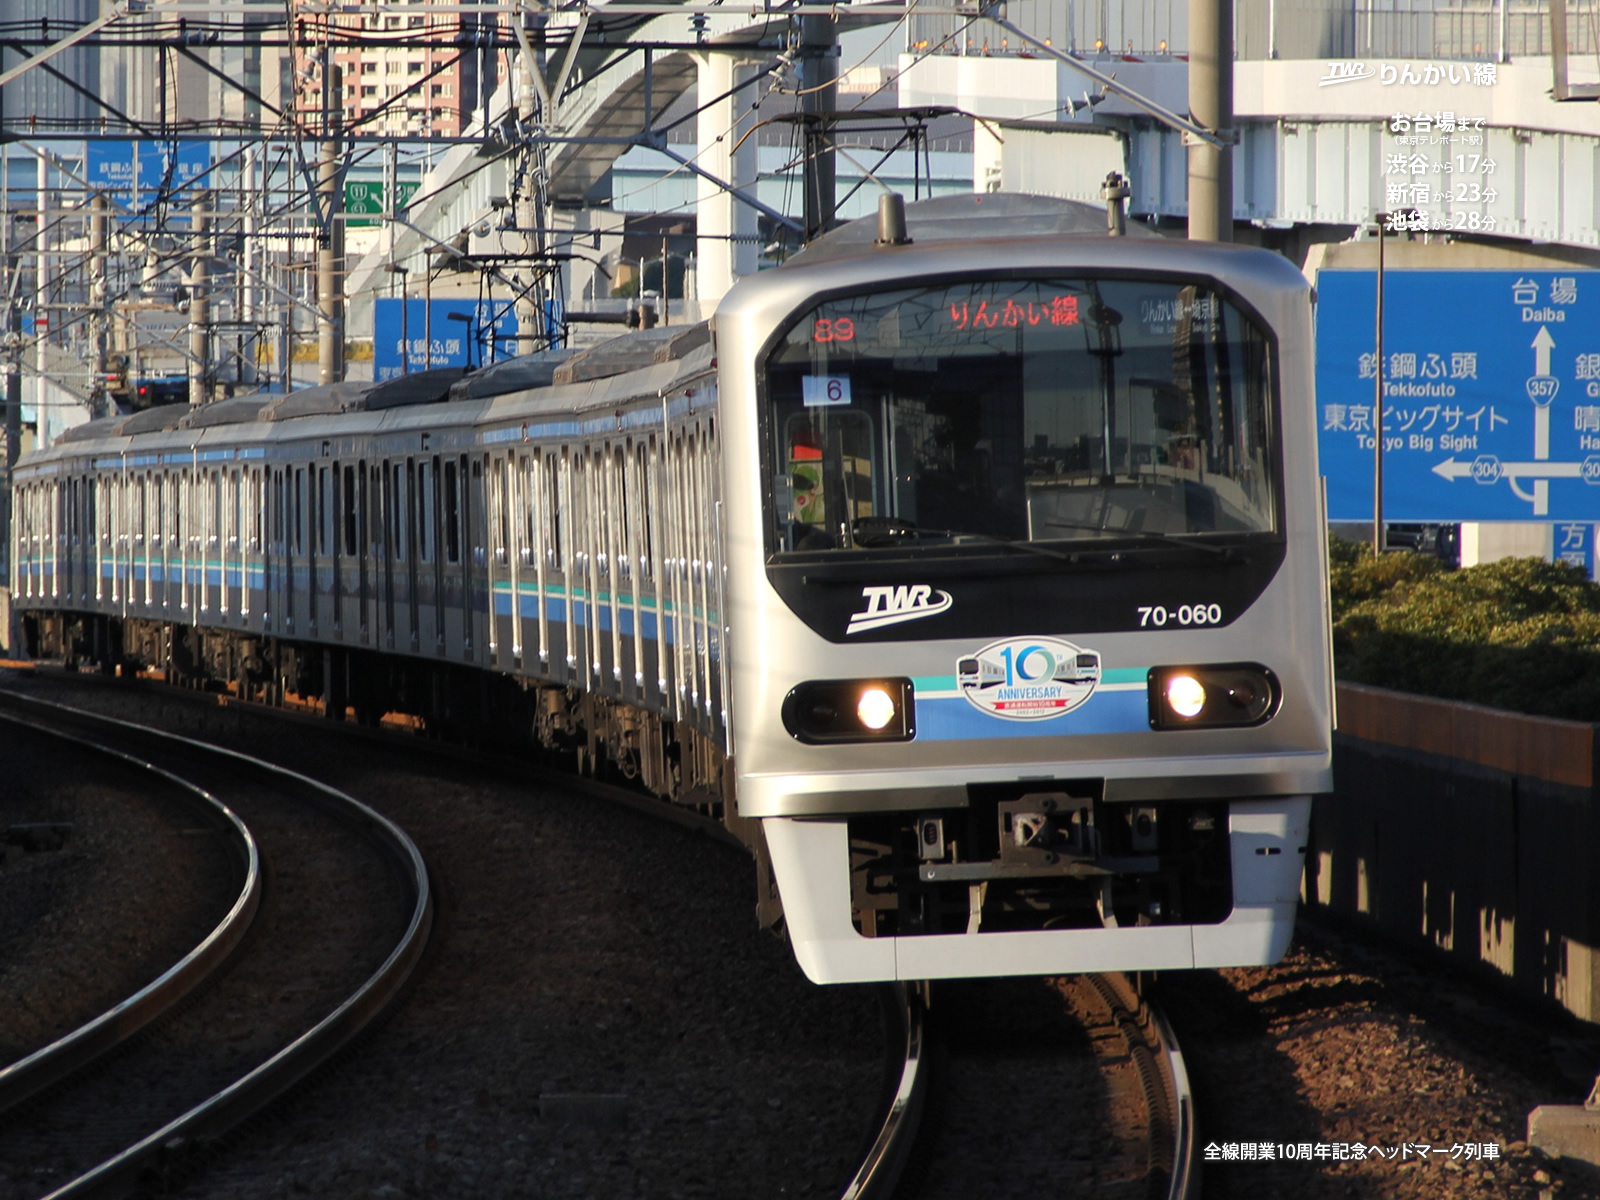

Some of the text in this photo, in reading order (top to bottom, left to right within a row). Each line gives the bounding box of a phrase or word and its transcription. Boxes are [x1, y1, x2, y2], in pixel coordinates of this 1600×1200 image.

[1511, 277, 1577, 305] 台場
[951, 295, 1079, 329] りんかい線
[1522, 307, 1566, 322] Daiba
[813, 317, 855, 343] 89
[1358, 352, 1478, 379] 鉄鋼ふ頭
[827, 379, 842, 402] 6
[1382, 382, 1456, 397] Tekkofuto
[1531, 381, 1554, 396] 357
[1323, 404, 1508, 432] 東京ビッグサイト
[1356, 434, 1403, 453] Toyo
[1409, 435, 1434, 452] Big
[1440, 434, 1478, 452] Sight
[1475, 462, 1498, 478] 304
[1137, 603, 1222, 627] 70-060
[997, 686, 1062, 701] ANNIVERSARY
